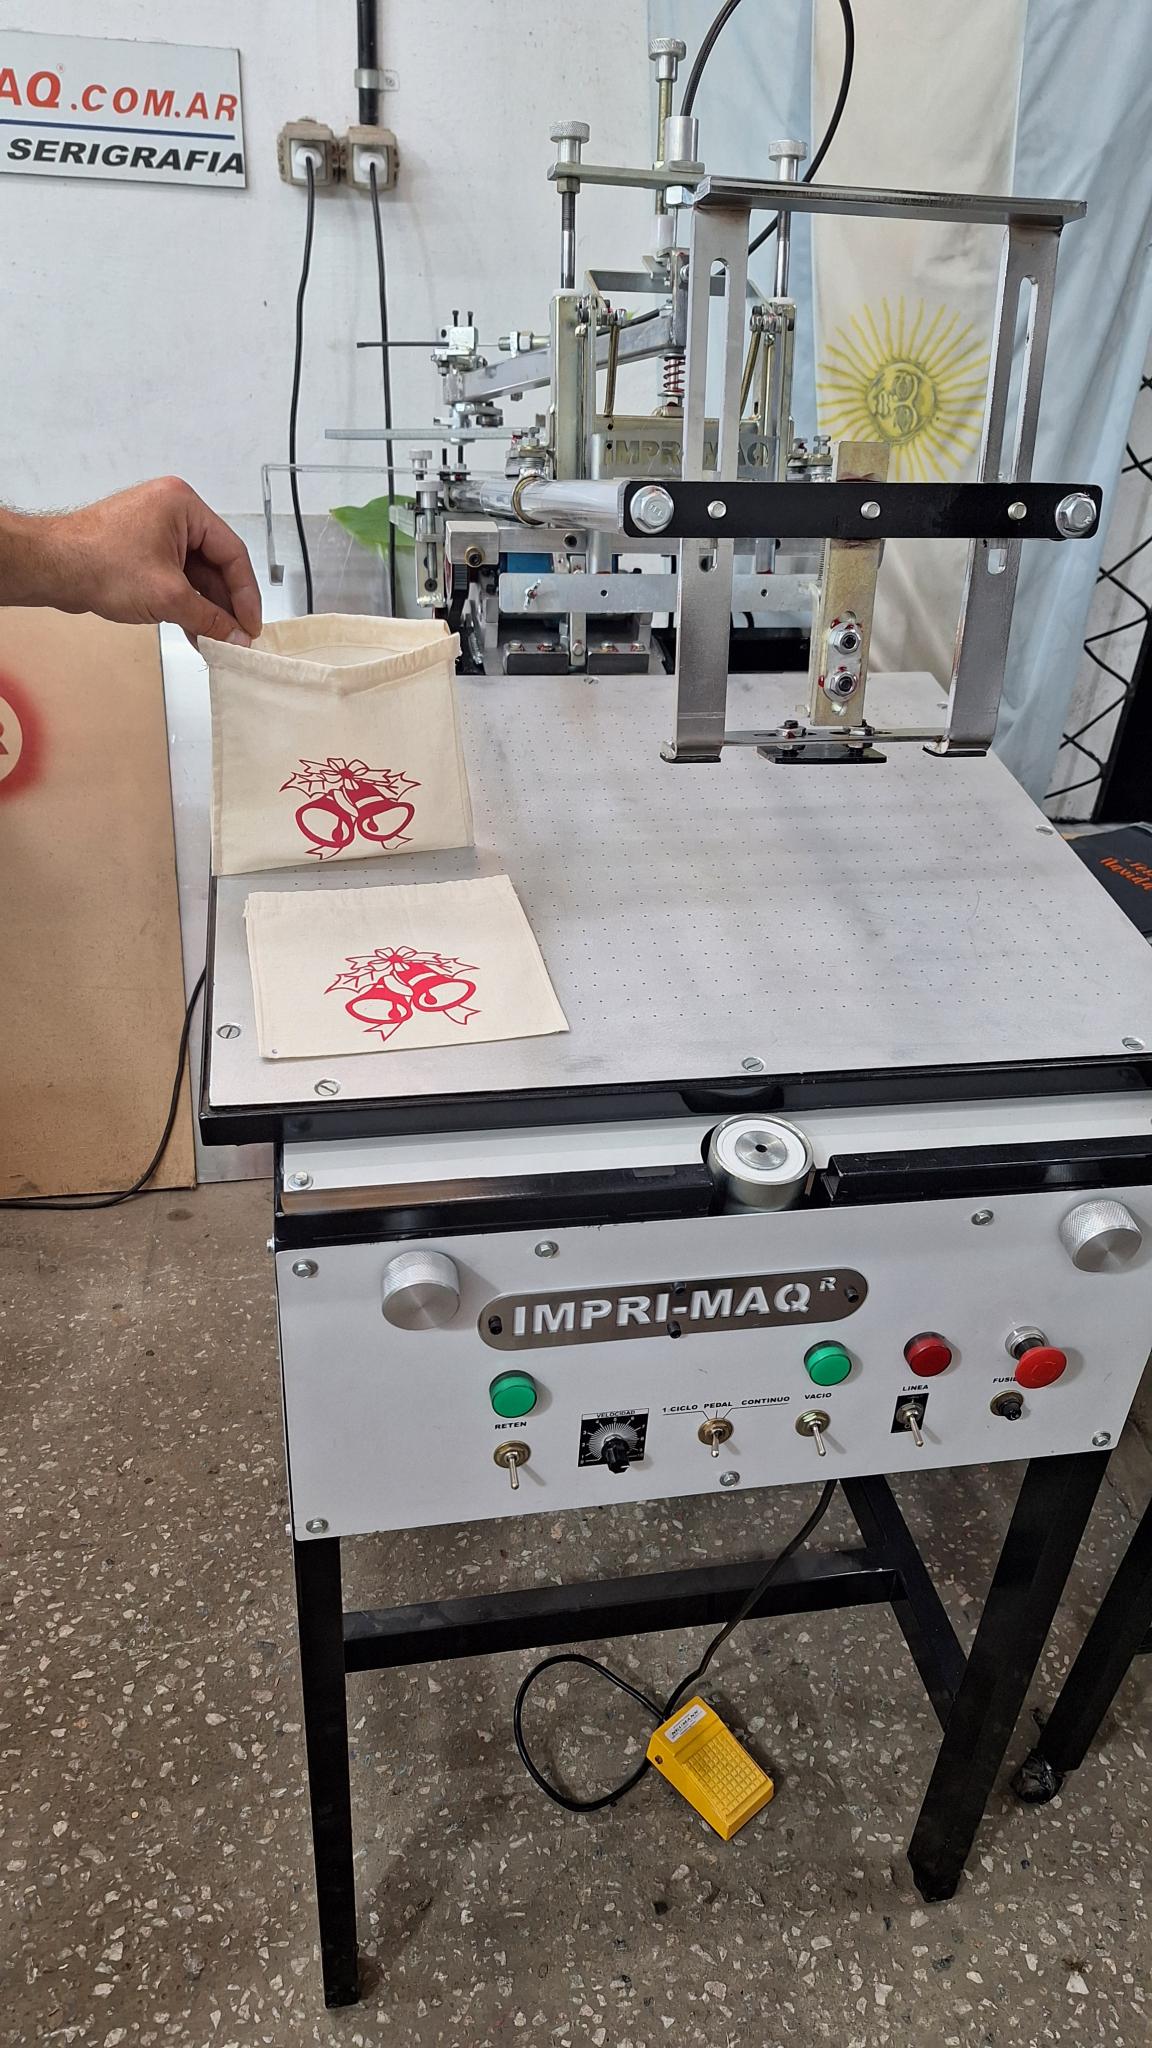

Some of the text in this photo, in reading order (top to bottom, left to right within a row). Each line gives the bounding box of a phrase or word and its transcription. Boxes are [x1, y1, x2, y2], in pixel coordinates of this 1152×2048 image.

[7, 138, 244, 174] SERIGRAFIA
[512, 1282, 811, 1336] IMPRI-MAQ
[670, 1404, 698, 1413] CICLO
[703, 1401, 733, 1409] PEDAL
[741, 1396, 790, 1405] CONTINUO
[804, 1392, 832, 1400] VACIO
[494, 1421, 527, 1430] RETEN
